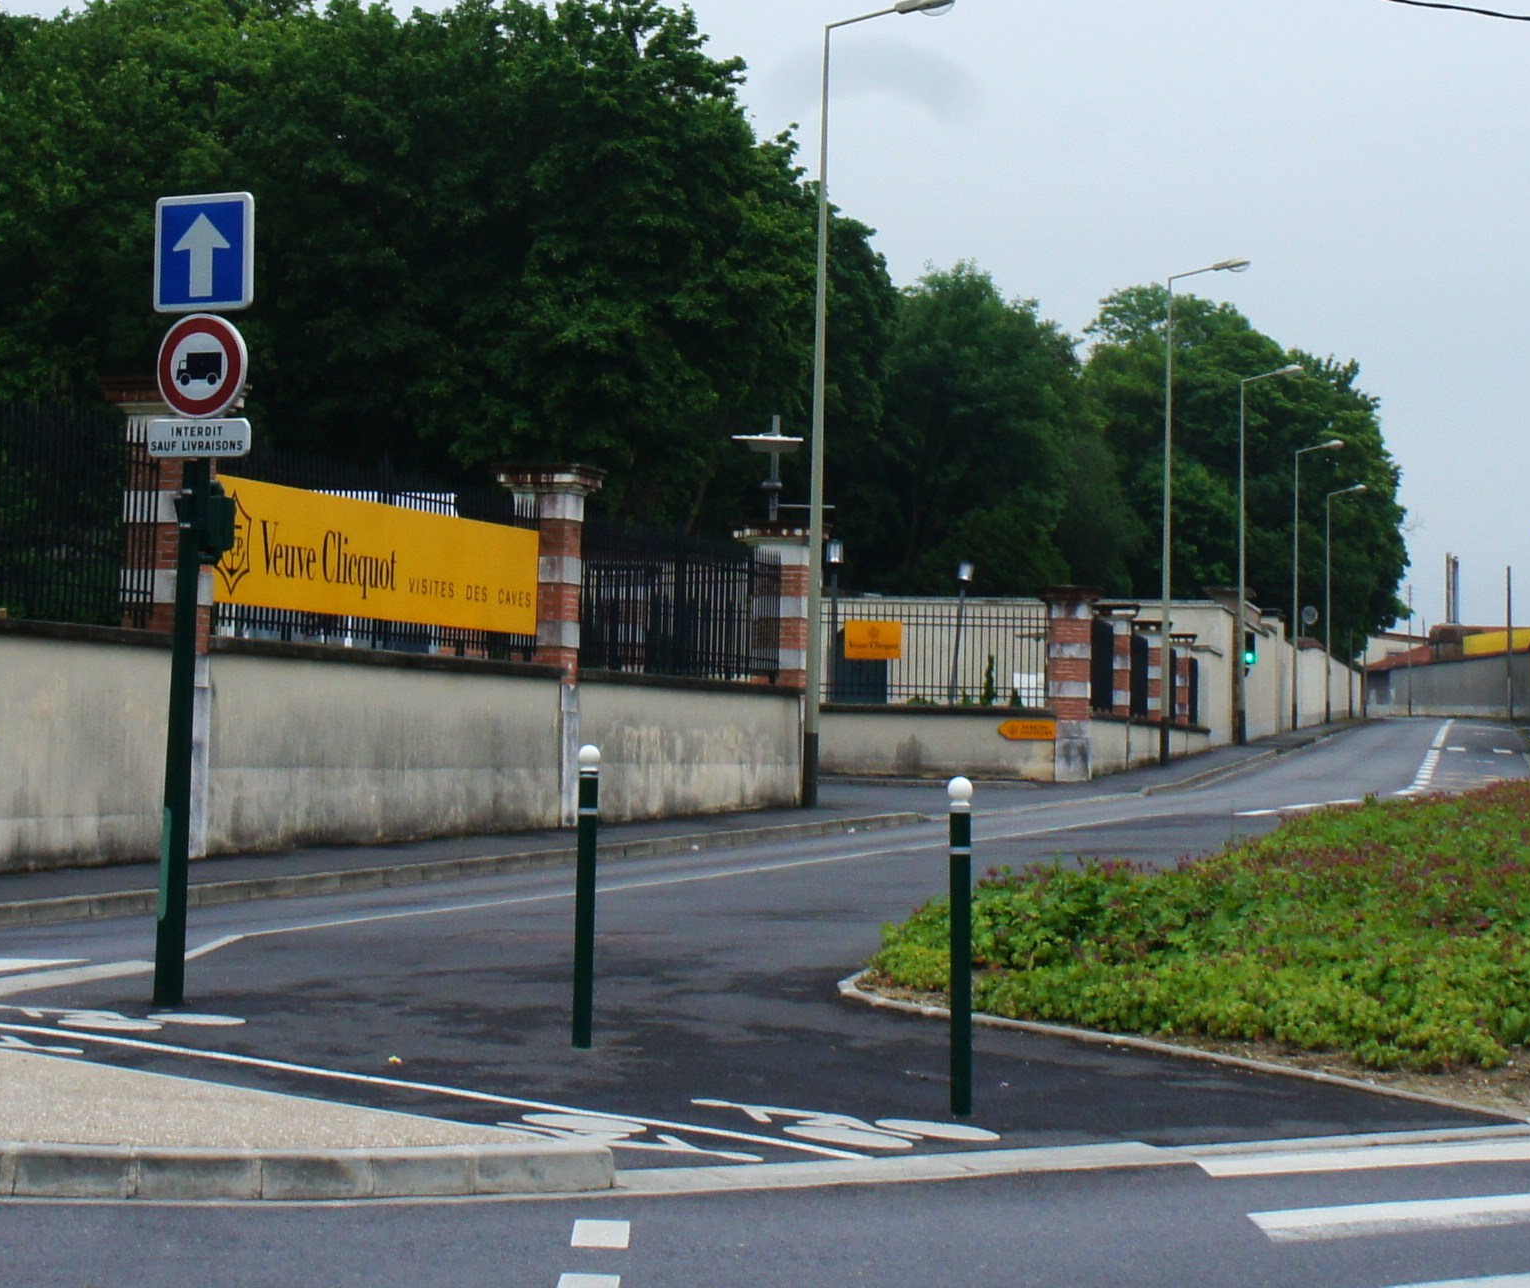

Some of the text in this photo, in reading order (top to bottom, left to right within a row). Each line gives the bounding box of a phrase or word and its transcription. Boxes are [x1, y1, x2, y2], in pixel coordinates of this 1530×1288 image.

[171, 426, 223, 437] INTERDIT
[150, 440, 243, 452] SAUF LIVRAISONS
[260, 519, 397, 599] Veuve Clicquot
[408, 577, 531, 608] VISITES DES CAVES
